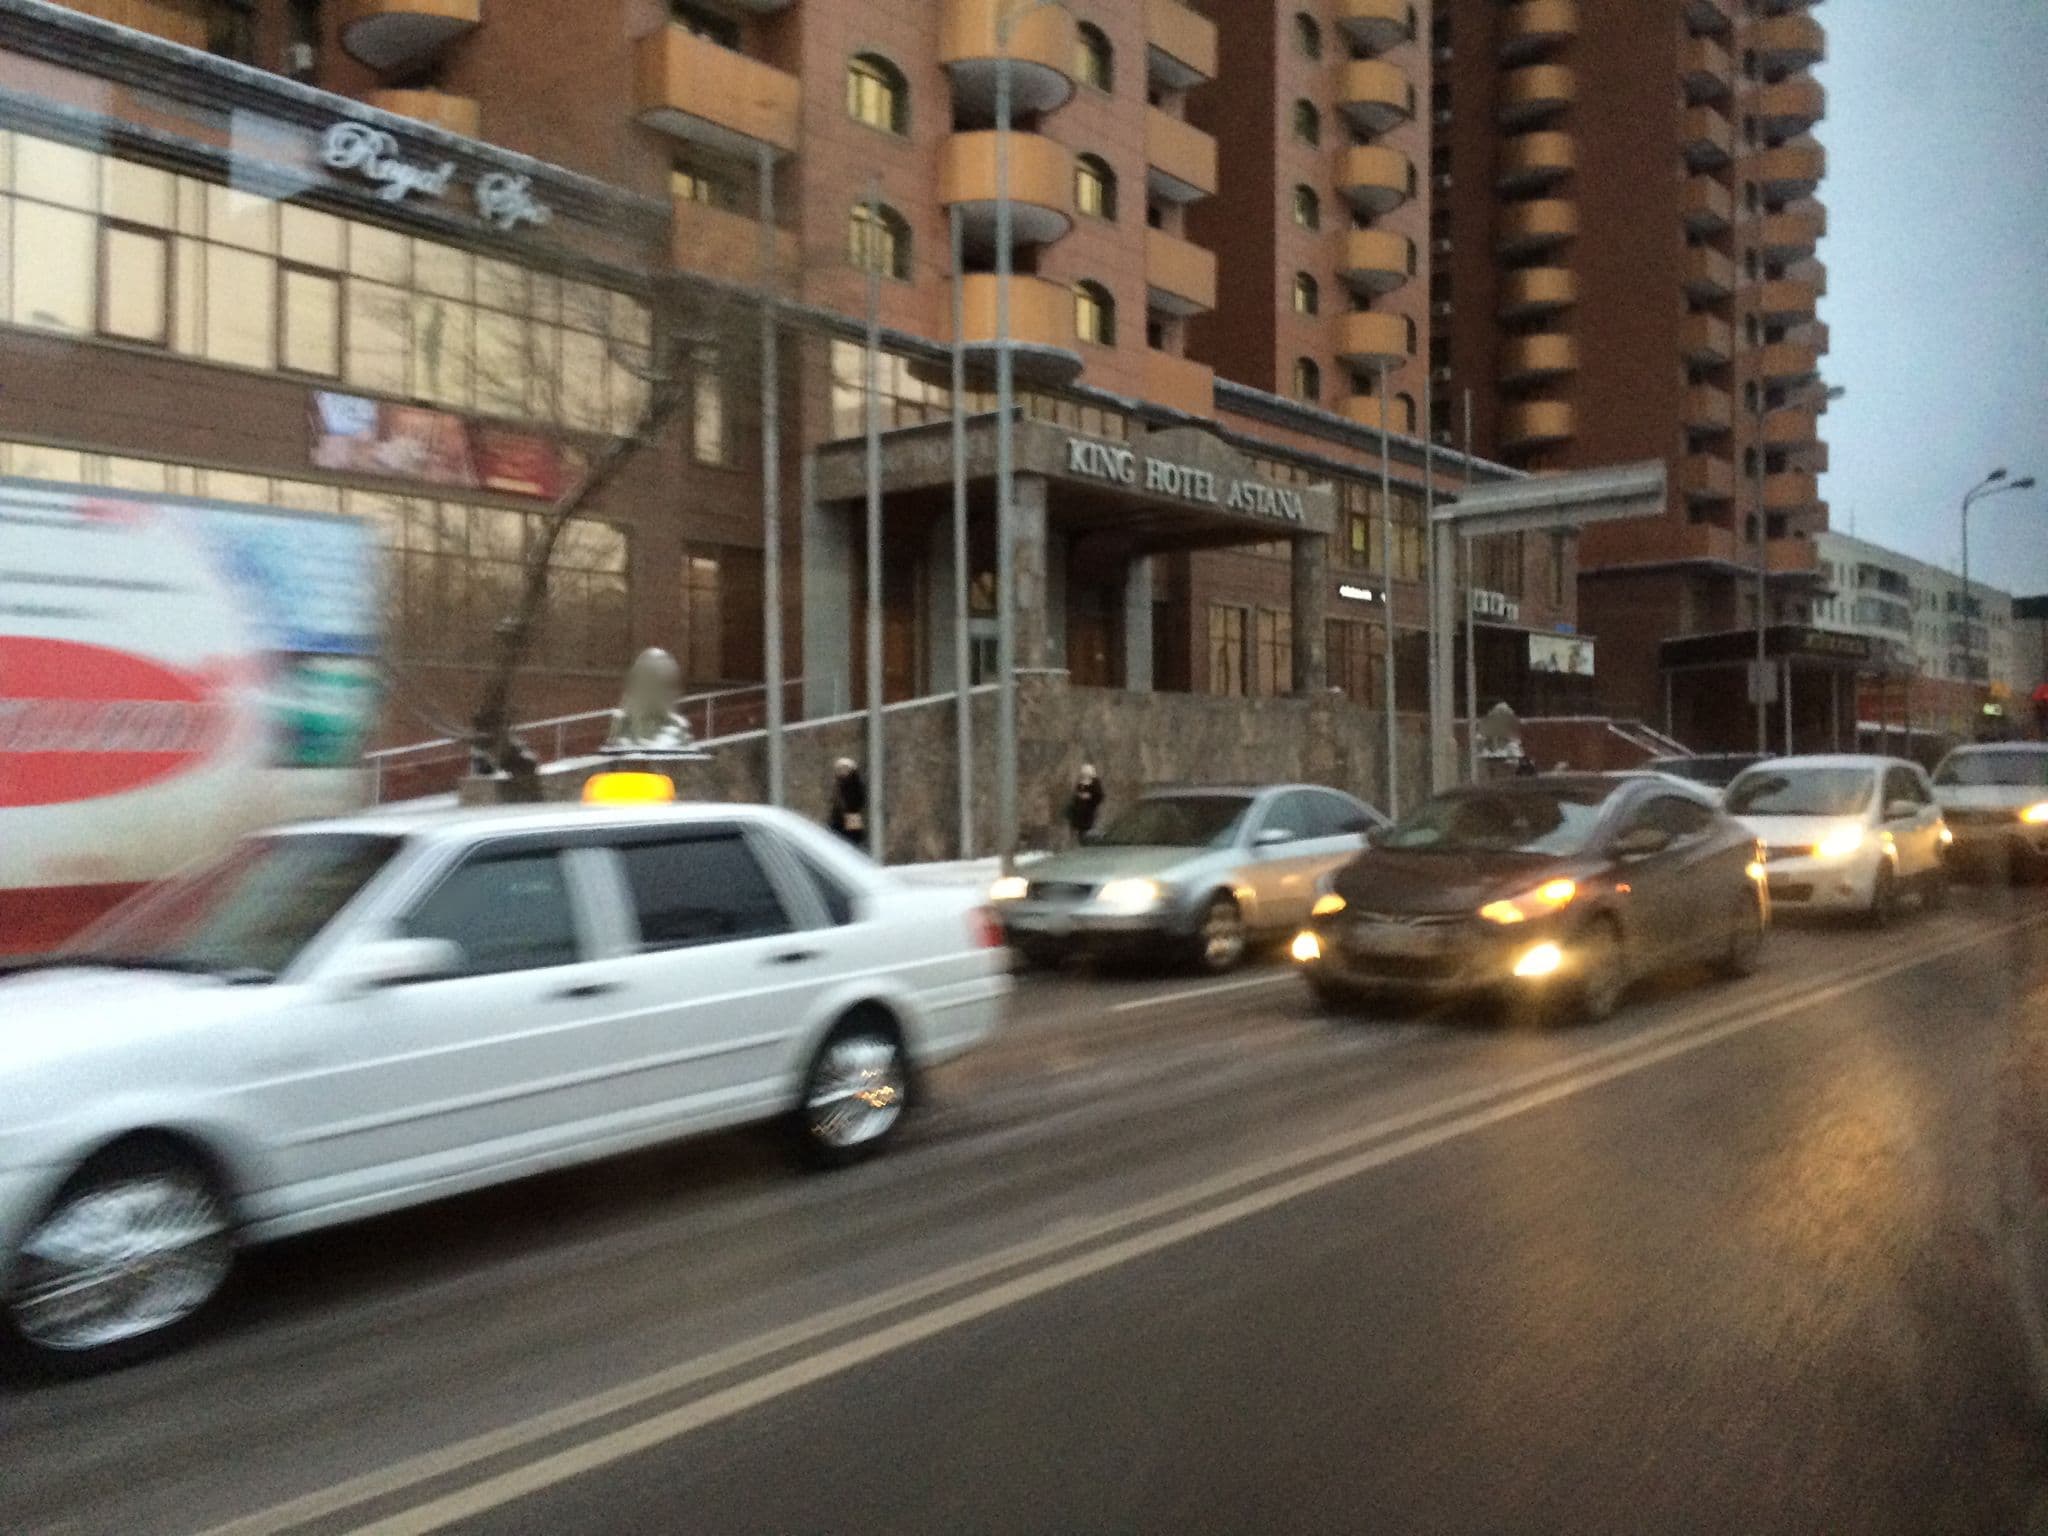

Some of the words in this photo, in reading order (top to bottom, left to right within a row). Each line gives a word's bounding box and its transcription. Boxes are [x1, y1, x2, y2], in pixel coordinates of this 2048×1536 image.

[1067, 438, 1136, 484] KING
[1145, 456, 1218, 503] HOTEL
[1228, 479, 1305, 521] ASTANA
